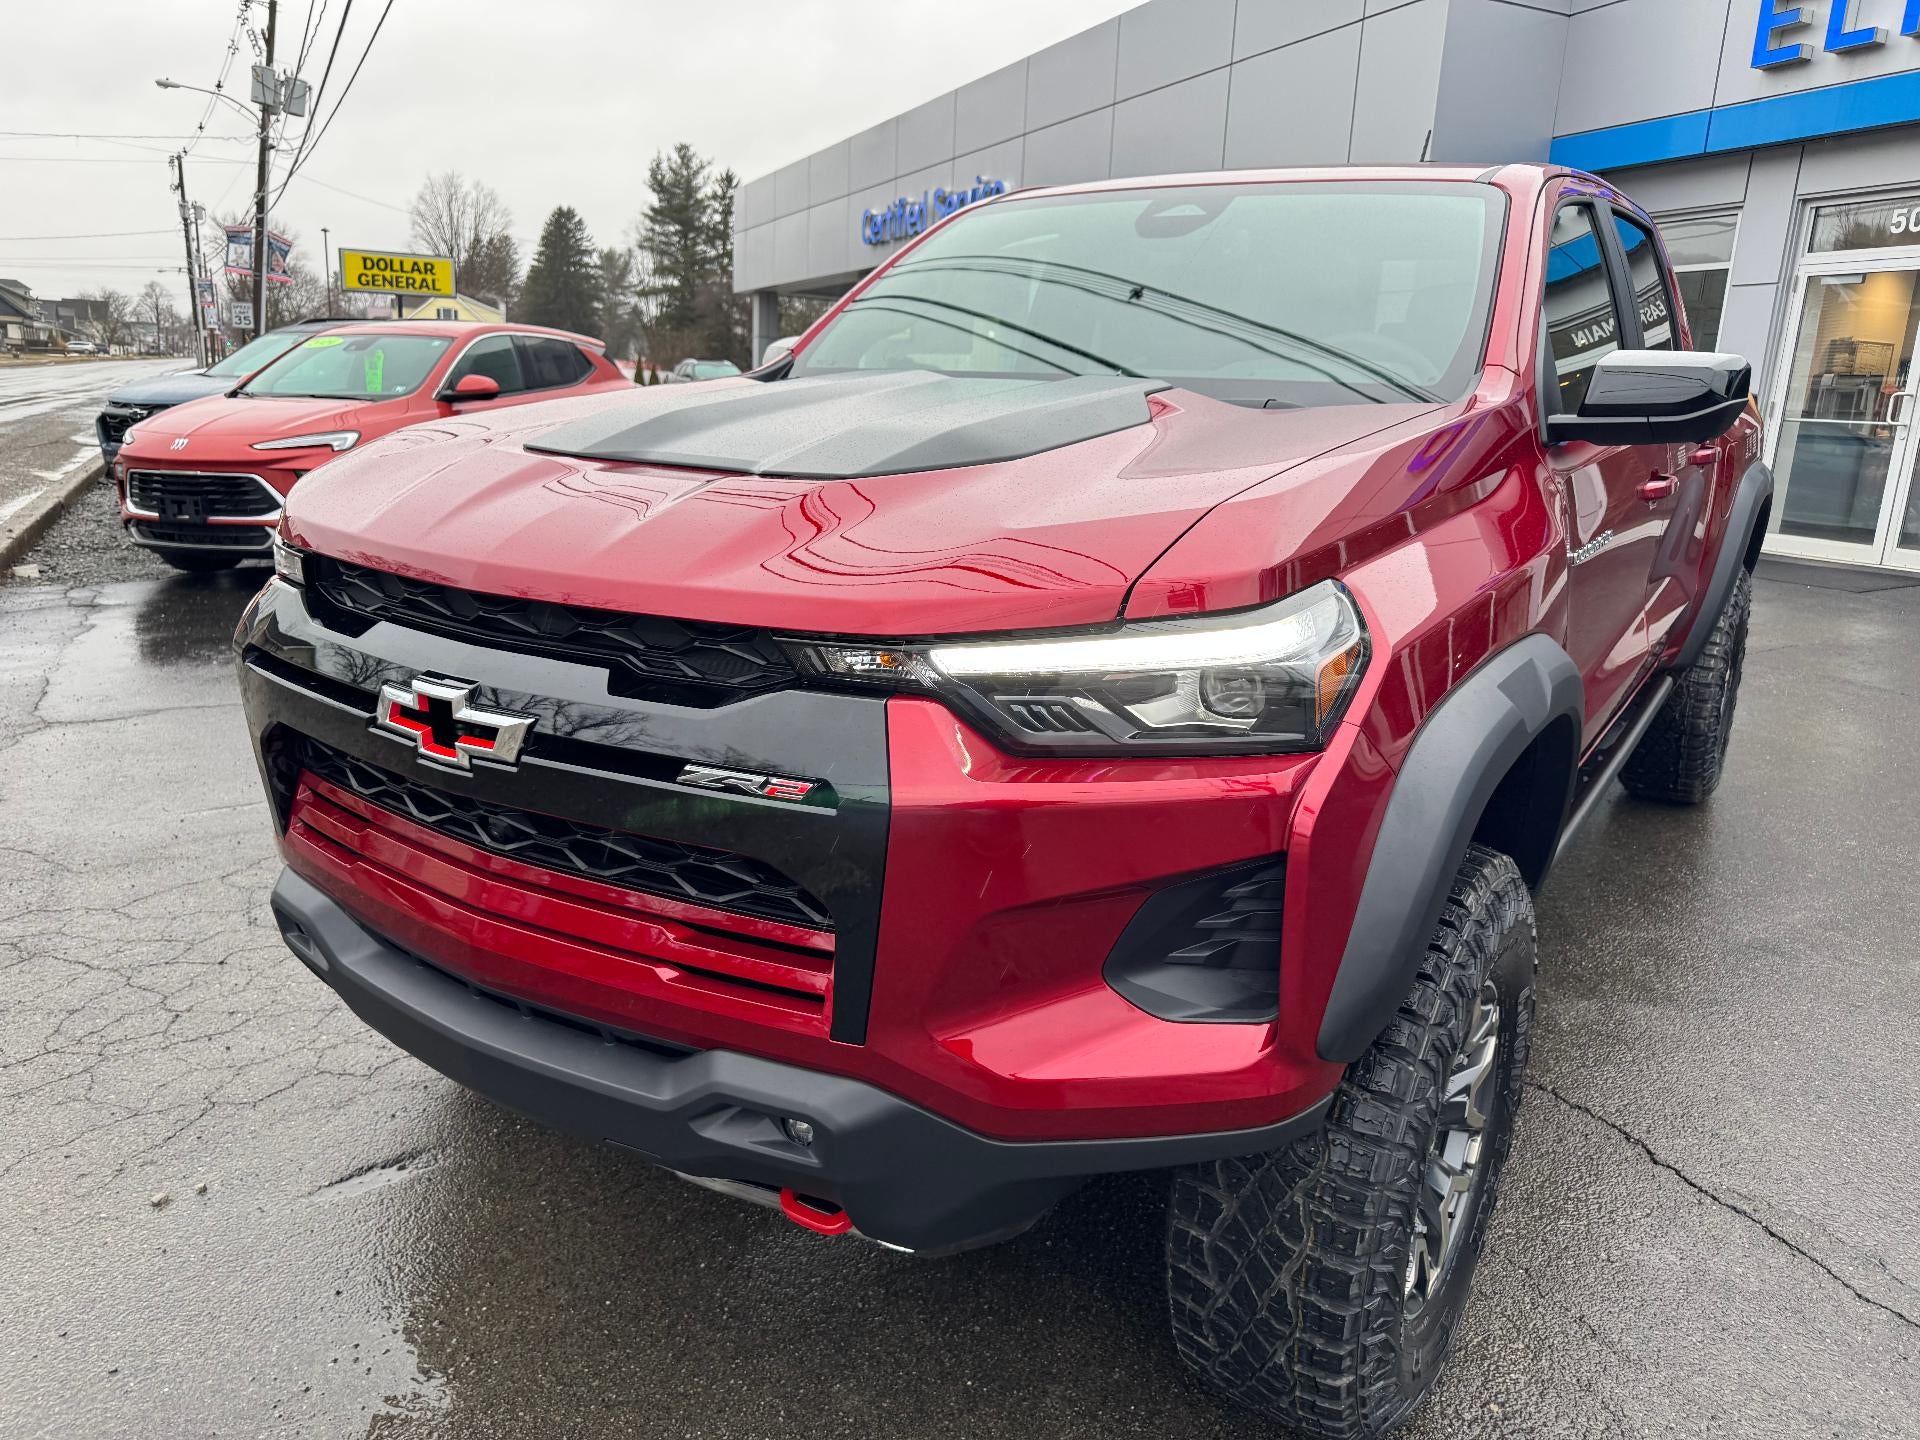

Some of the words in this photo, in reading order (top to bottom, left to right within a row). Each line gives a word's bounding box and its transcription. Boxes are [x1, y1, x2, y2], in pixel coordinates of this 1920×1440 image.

[1751, 0, 1920, 69] EL
[862, 190, 928, 245] Certified
[933, 175, 1004, 217] Service
[361, 256, 436, 276] DOLLAR
[357, 273, 442, 291] GENERAL
[234, 315, 252, 326] 35
[676, 763, 814, 801] ZR2
